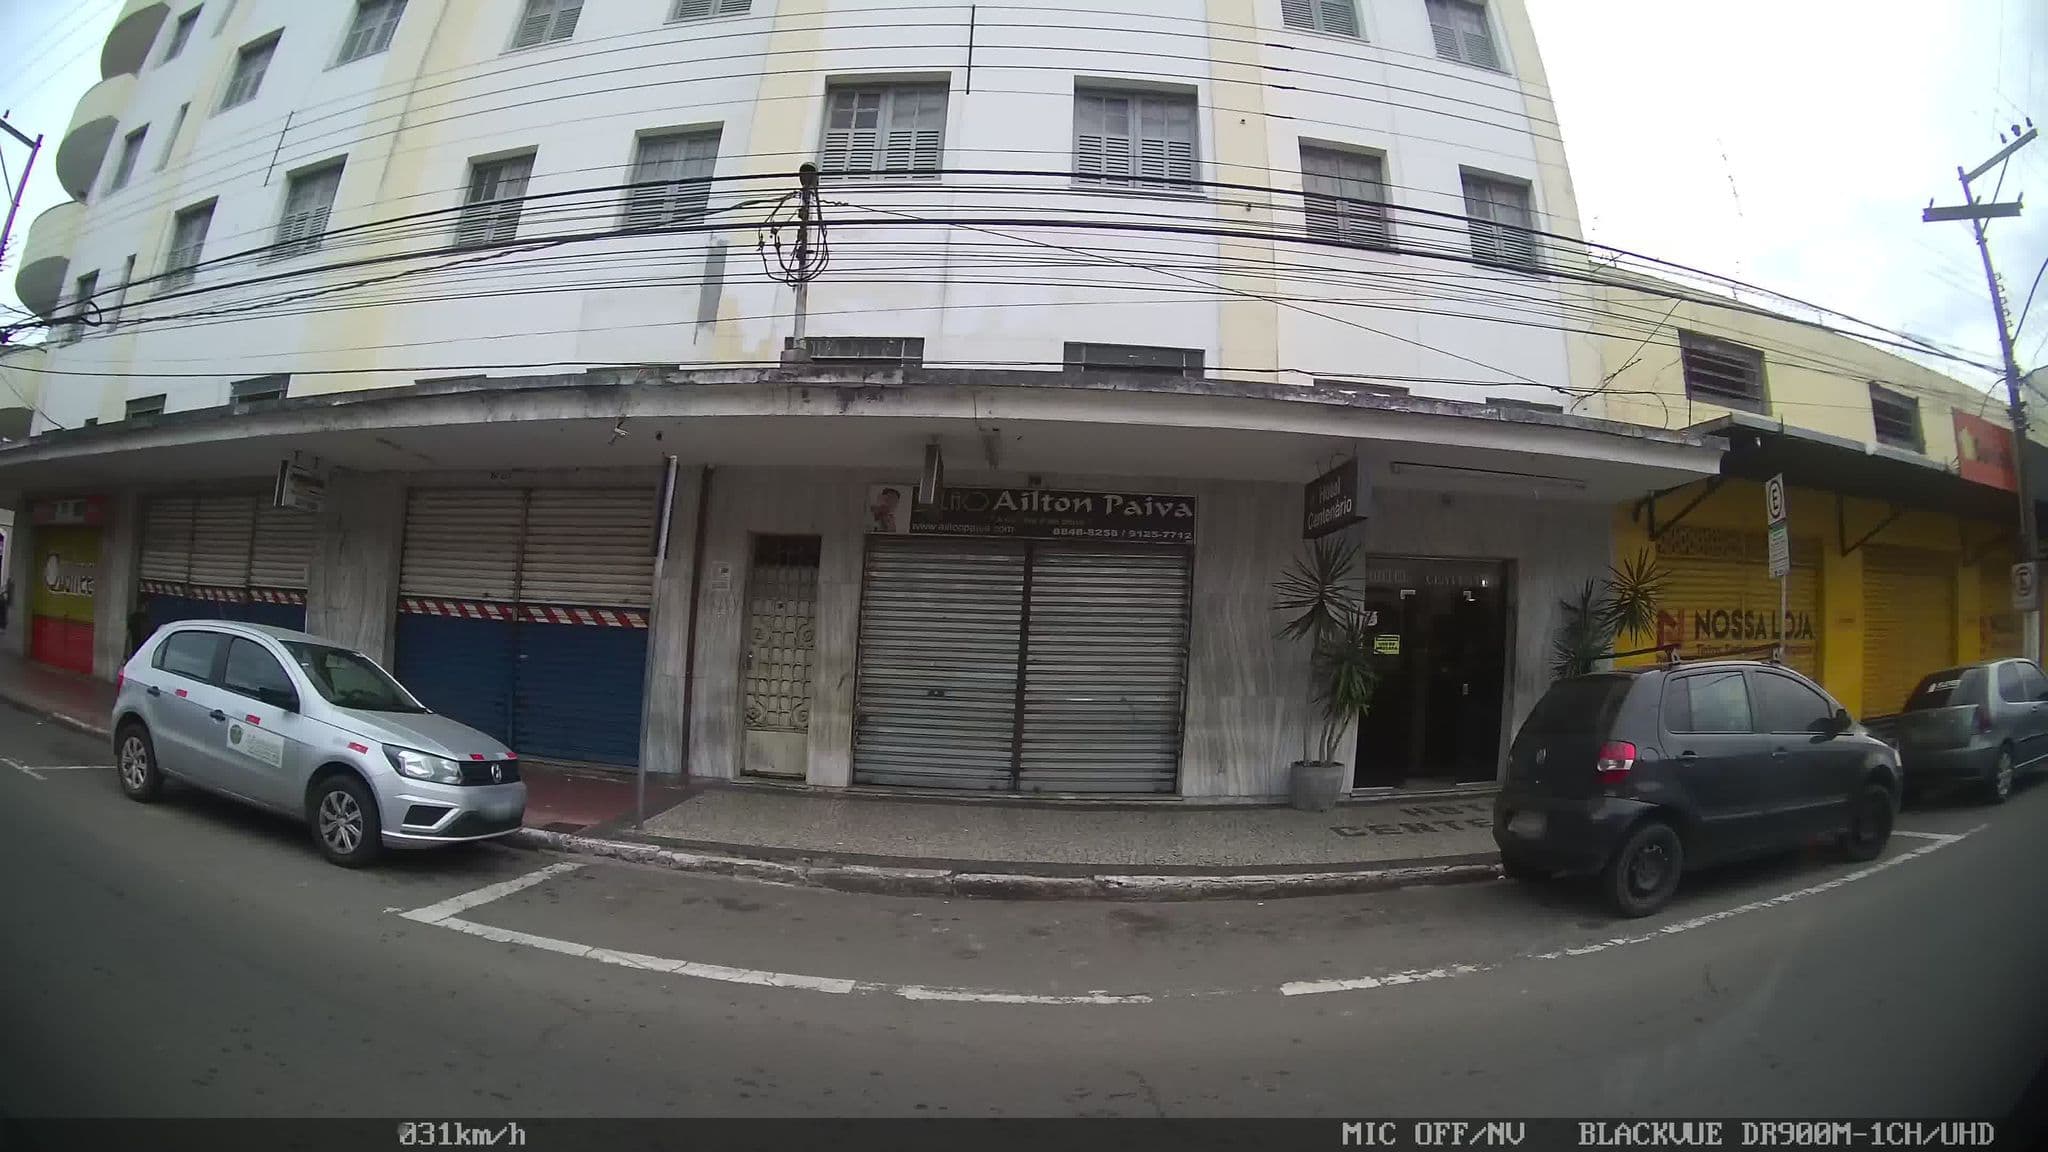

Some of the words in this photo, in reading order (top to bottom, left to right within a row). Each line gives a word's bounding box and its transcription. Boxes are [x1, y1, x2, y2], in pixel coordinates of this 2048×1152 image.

[993, 489, 1092, 513] Ailton
[1101, 494, 1194, 518] Paiva
[1695, 610, 1767, 640] NOSSA
[1772, 610, 1815, 640] LOJA
